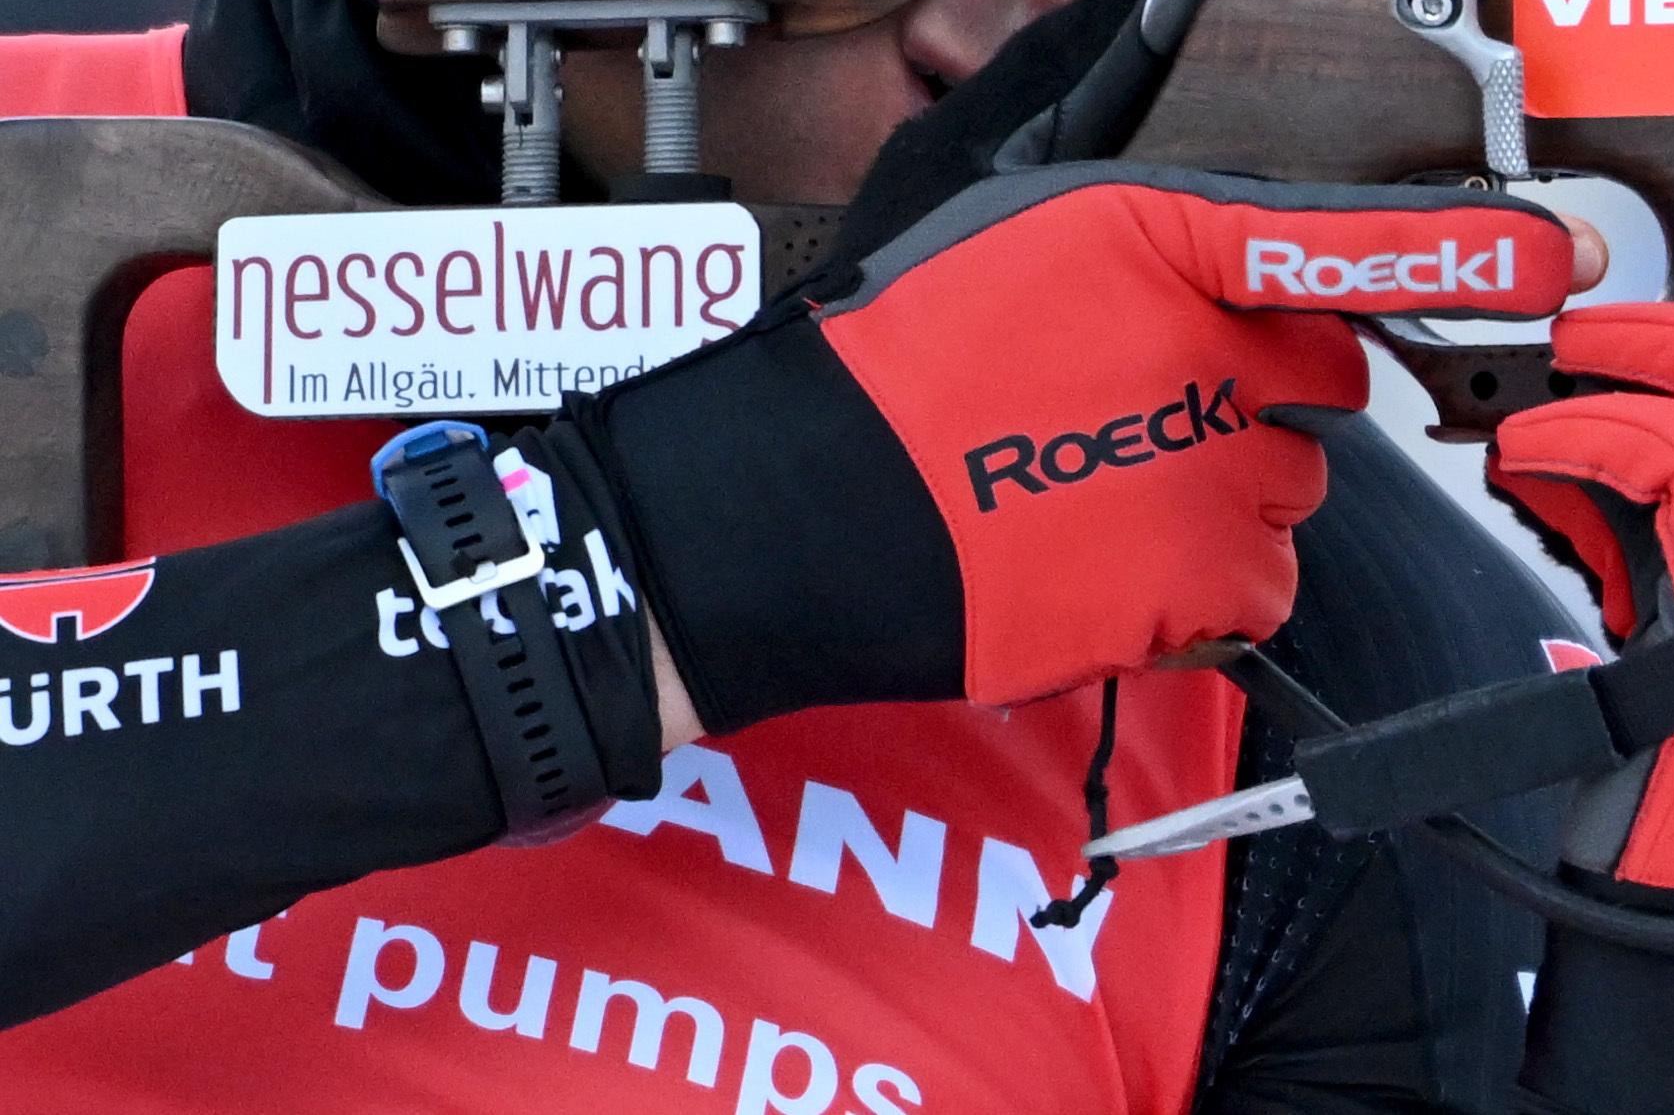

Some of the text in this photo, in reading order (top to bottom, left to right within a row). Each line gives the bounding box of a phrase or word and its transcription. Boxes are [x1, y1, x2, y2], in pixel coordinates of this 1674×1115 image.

[232, 221, 745, 404] nesselwang
[288, 355, 677, 407] Im Allgäu. Mittend
[335, 916, 923, 1115] pumps
